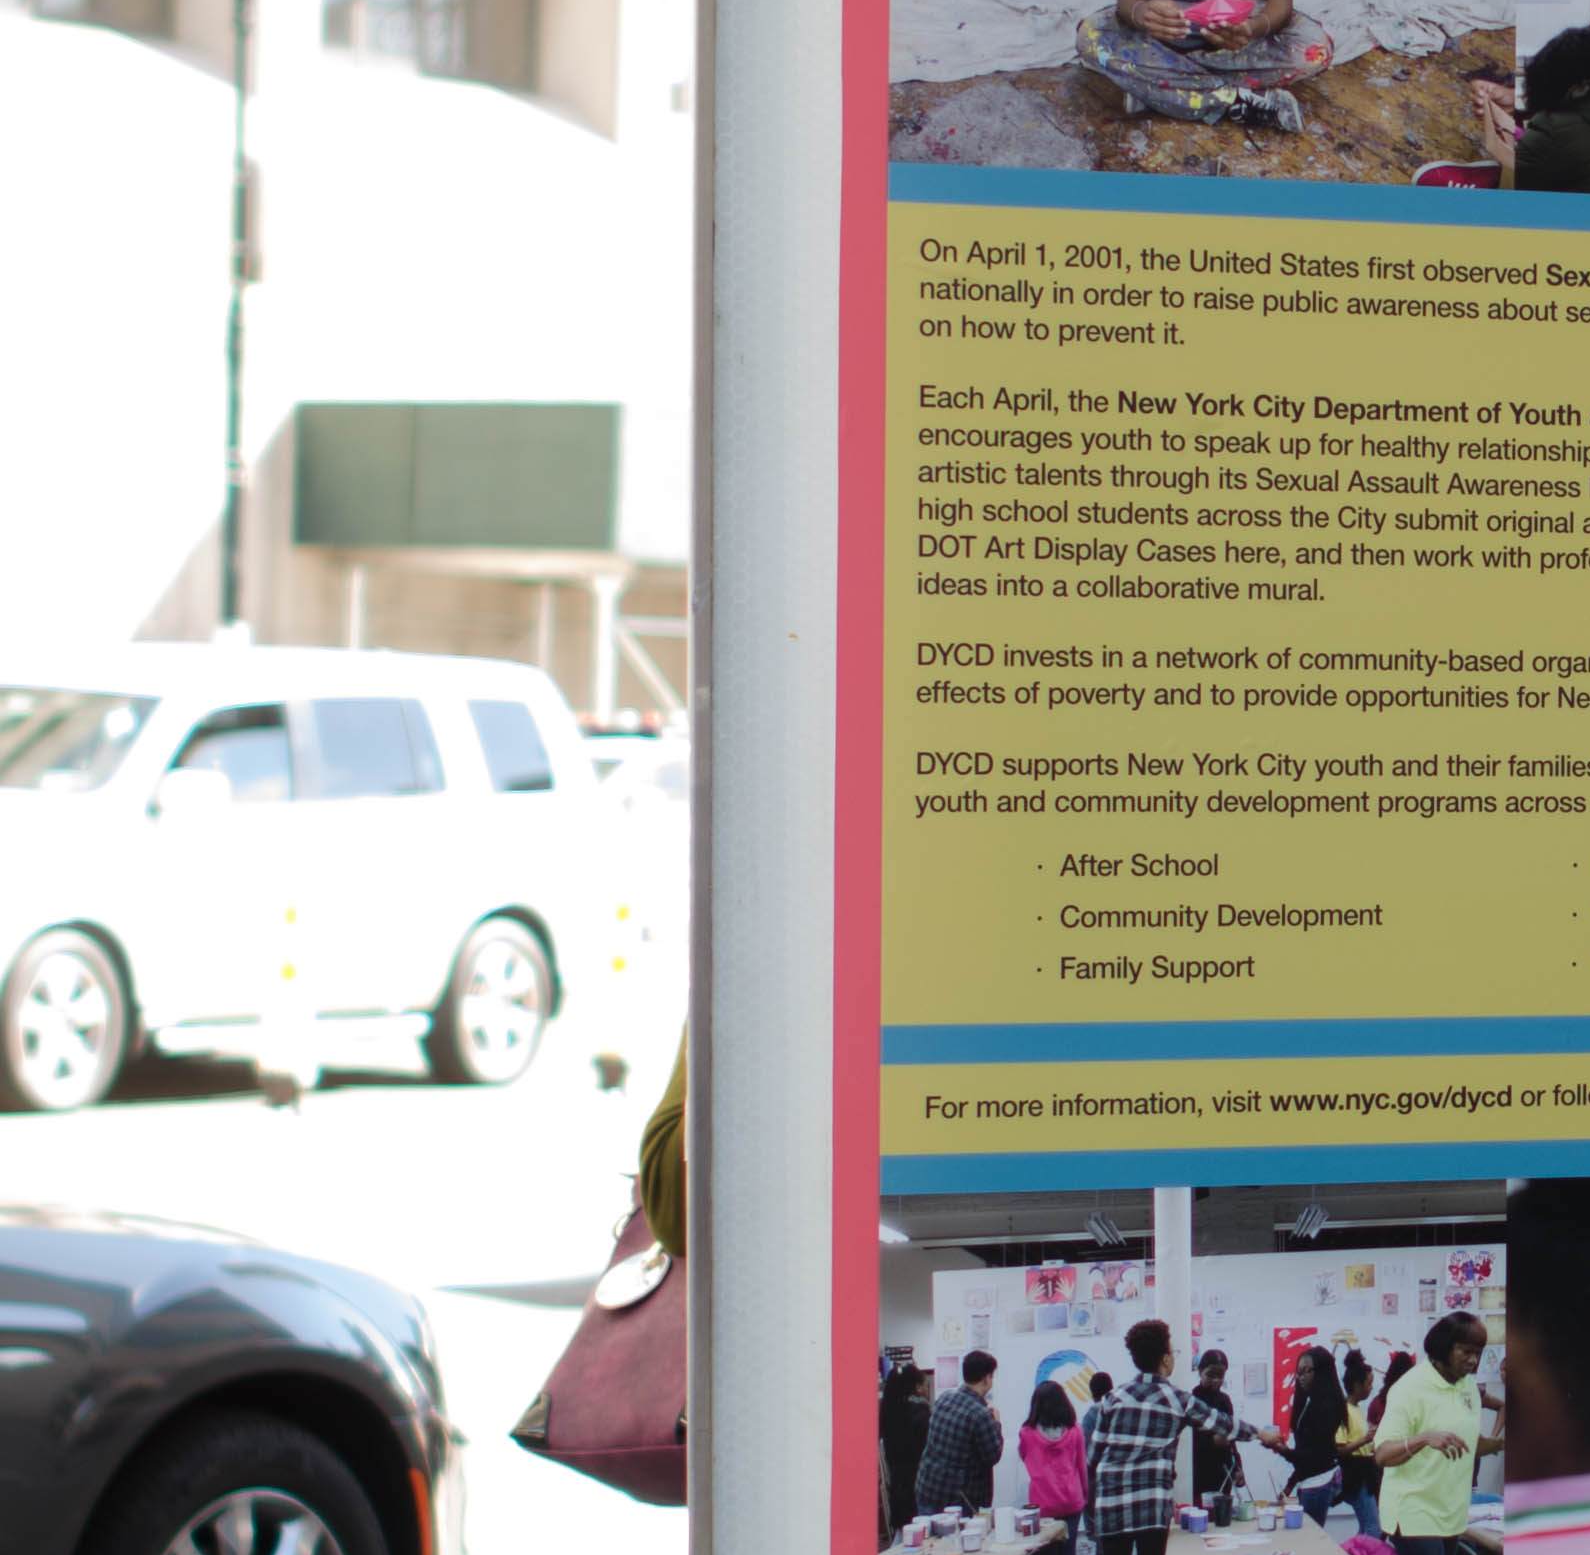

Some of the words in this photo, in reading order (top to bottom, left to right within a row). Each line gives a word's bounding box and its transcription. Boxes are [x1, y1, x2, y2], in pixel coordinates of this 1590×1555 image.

[919, 237, 958, 263] On
[965, 239, 1026, 271] April
[1035, 243, 1055, 272] 1,
[1063, 244, 1132, 274] 2001,
[1139, 246, 1181, 272] the
[1189, 248, 1272, 275] United
[1279, 251, 1360, 279] States
[1365, 255, 1416, 281] first
[1422, 258, 1538, 286] observed
[919, 276, 1045, 310] nationally
[1052, 279, 1075, 305] in
[1082, 282, 1153, 308] order
[1159, 285, 1185, 309] to
[1193, 285, 1255, 311] raise
[1262, 288, 1339, 318] public
[1345, 296, 1480, 320] awareness
[1486, 296, 1559, 323] about
[919, 383, 985, 410] Each
[991, 385, 1059, 417] April,
[1067, 388, 1110, 414] the
[1117, 389, 1178, 415] New
[1184, 391, 1246, 418] York
[1252, 393, 1306, 424] City
[1313, 395, 1470, 426] Department
[1475, 400, 1503, 424] of
[1507, 401, 1582, 427] Youth
[1059, 853, 1124, 878] After
[1129, 852, 1219, 877] School
[1059, 903, 1209, 934] Community
[1217, 902, 1384, 932] Development
[1059, 955, 1144, 985] Family
[1151, 954, 1256, 984] Support
[924, 1095, 970, 1120] For
[975, 1099, 1044, 1119] more
[1051, 1091, 1203, 1119] information,
[1211, 1088, 1262, 1114] visit
[1268, 1084, 1513, 1116] www.nyc.gov/dycd
[1519, 1088, 1547, 1108] or
